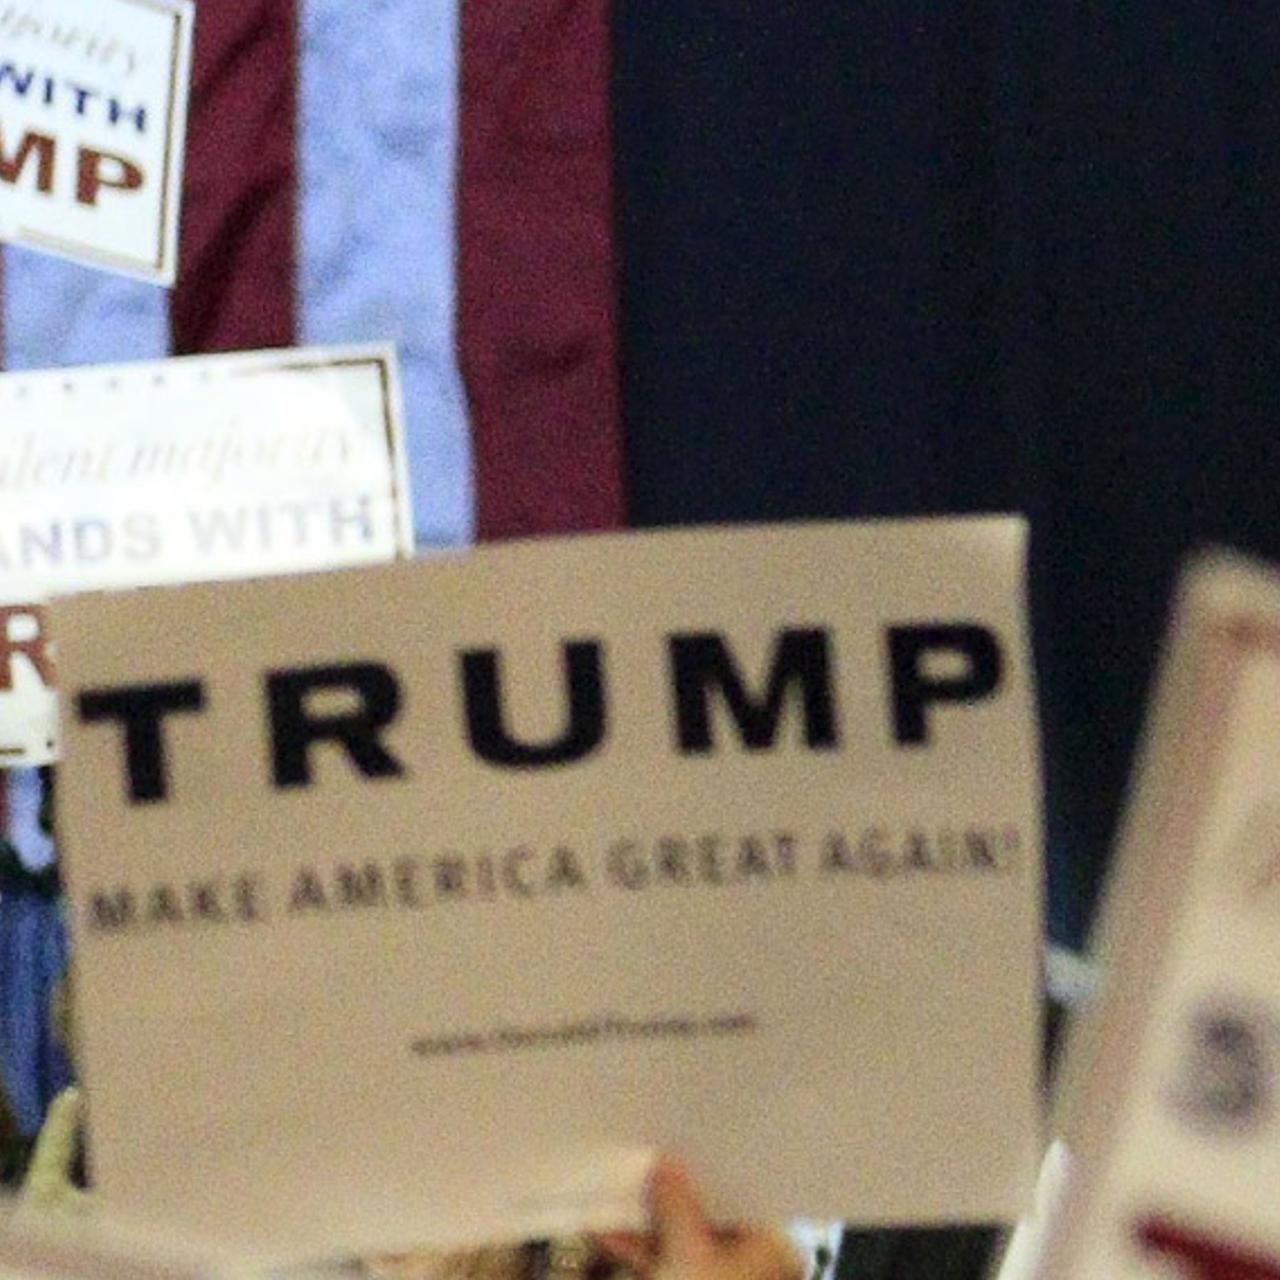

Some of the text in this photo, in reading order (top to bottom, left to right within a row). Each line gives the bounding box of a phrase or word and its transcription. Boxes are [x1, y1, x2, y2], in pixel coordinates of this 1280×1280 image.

[188, 494, 378, 557] WITH
[75, 621, 1006, 807] TRUMP
[86, 878, 277, 932] MAKE
[287, 842, 585, 914] AMERICA
[604, 829, 799, 893] GREAT
